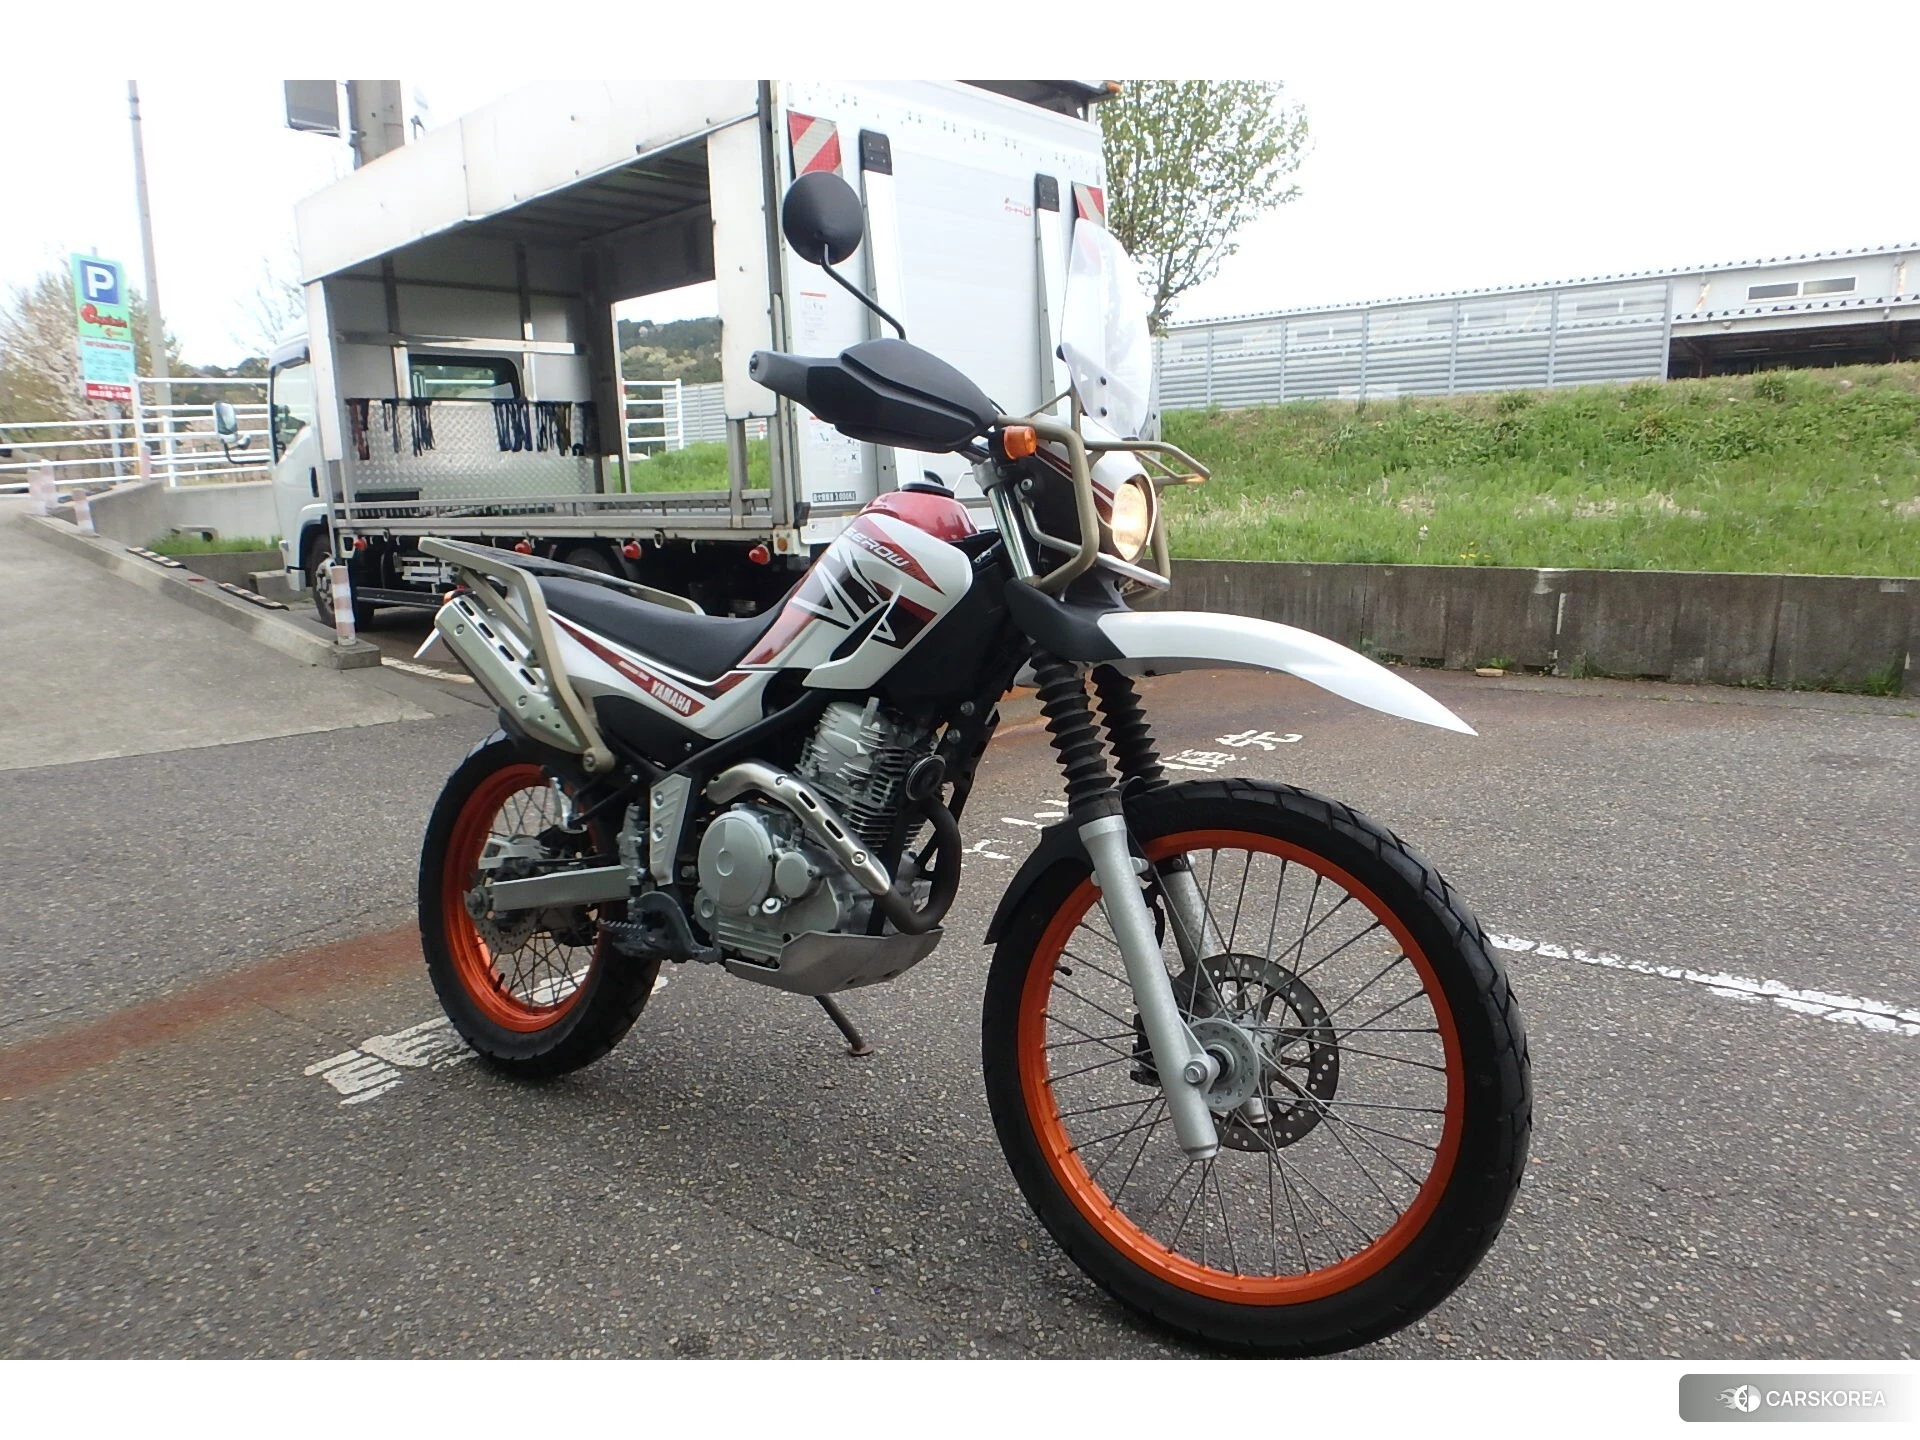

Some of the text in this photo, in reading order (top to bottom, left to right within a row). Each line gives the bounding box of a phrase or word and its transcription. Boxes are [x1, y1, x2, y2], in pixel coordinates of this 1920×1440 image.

[86, 265, 114, 298] P
[842, 526, 910, 567] SEROW
[651, 680, 692, 714] YAMAHA
